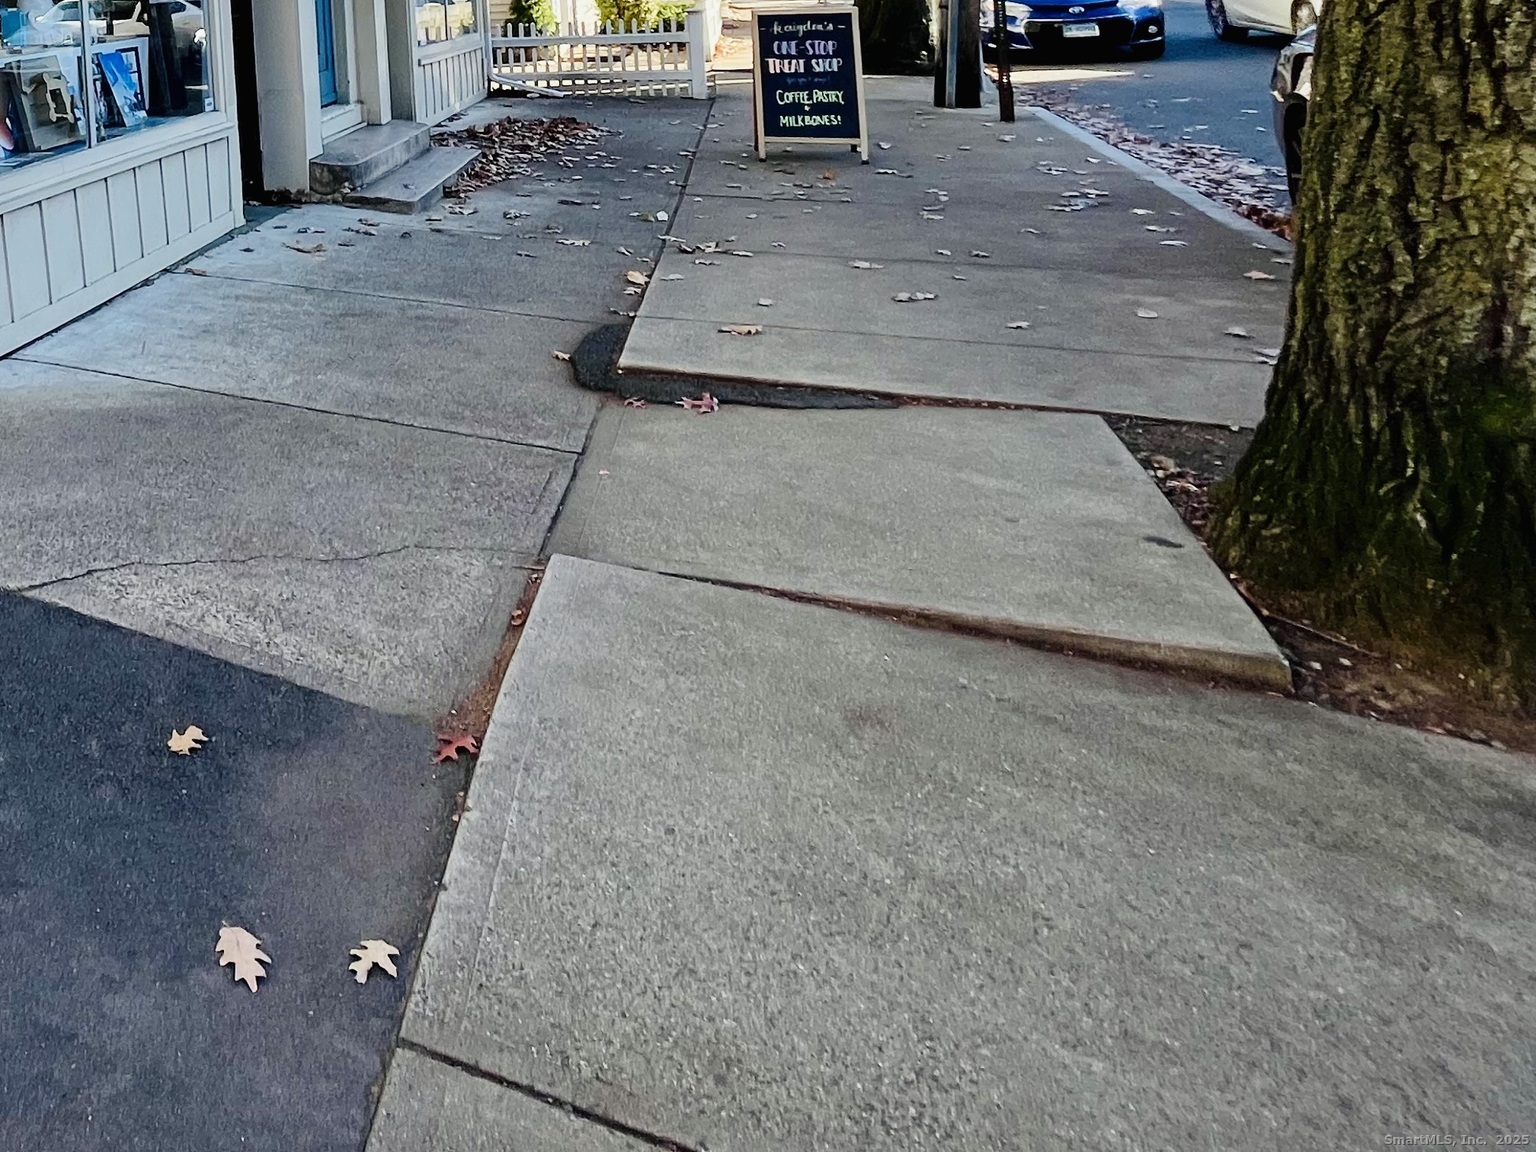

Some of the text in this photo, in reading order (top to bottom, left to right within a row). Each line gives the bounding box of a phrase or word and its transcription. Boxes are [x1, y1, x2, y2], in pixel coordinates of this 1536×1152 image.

[773, 39, 837, 56] ONE-STOP
[764, 57, 843, 74] TREAT SHOP
